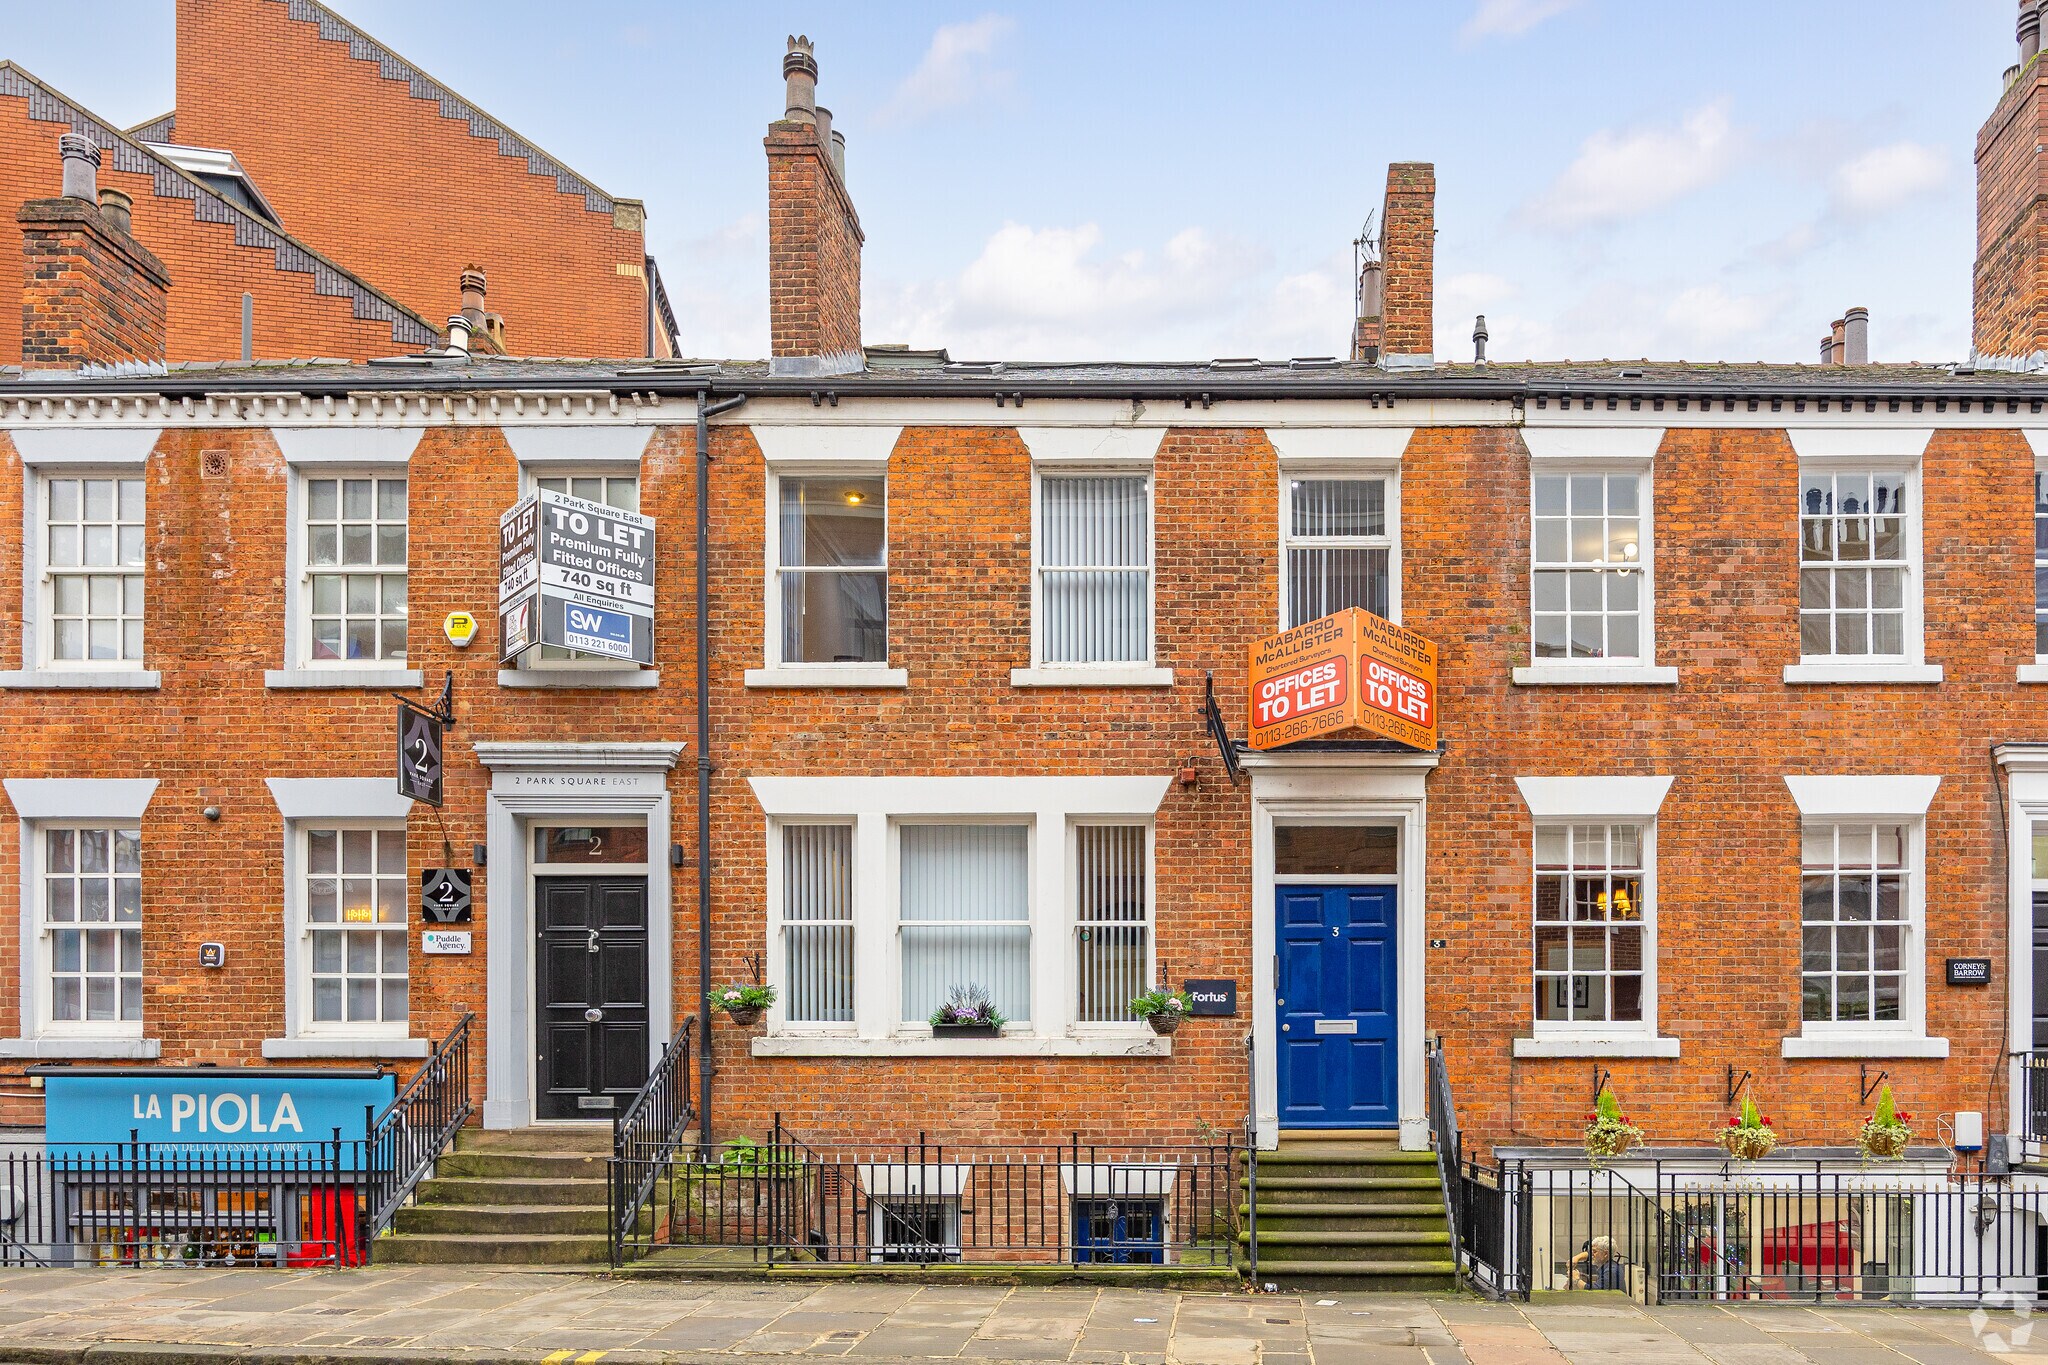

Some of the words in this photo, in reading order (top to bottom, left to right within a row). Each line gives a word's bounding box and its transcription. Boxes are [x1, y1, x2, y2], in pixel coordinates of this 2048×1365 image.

[554, 494, 560, 503] 2
[563, 497, 585, 510] Park
[588, 503, 620, 519] Square
[623, 512, 643, 525] East
[502, 522, 515, 547] TO
[517, 506, 535, 538] LET
[552, 506, 589, 535] TO
[598, 519, 645, 550] LET
[502, 542, 522, 564] Premium
[522, 533, 534, 550] Fully
[550, 532, 611, 558] Premium
[615, 548, 645, 568] Fully
[502, 561, 516, 580] Fitted
[516, 551, 534, 570] Offices
[504, 578, 514, 594] 740
[516, 574, 522, 588] sq
[524, 568, 528, 581] ft
[553, 550, 592, 572] Fitted
[596, 560, 643, 581] Offices
[560, 570, 590, 587] 740
[596, 579, 614, 596] sq
[620, 582, 632, 596] ft
[574, 593, 584, 601] All
[586, 596, 624, 610] Enquiries
[570, 610, 602, 632] SW
[1263, 618, 1335, 652] NABARRO
[1370, 616, 1426, 651] NABARRO
[569, 634, 589, 646] 0113
[592, 638, 606, 648] 221
[608, 642, 628, 653] 6000
[1255, 628, 1343, 666] McALLISTER
[1363, 626, 1432, 666] McALLISTER
[1266, 657, 1298, 674] Chartered
[1299, 648, 1332, 664] Surveyors
[1372, 646, 1400, 664] Chartered
[1400, 657, 1424, 674] Surveyors
[1261, 663, 1337, 699] OFFICES
[1368, 662, 1426, 700] OFFICES
[1258, 696, 1290, 722] TO
[1296, 680, 1340, 712] LET
[1366, 679, 1393, 708] TO
[1397, 691, 1429, 722] LET
[1255, 710, 1344, 747] 0113-266-7666
[1363, 710, 1432, 746] 0113-266-7666
[415, 738, 428, 773] 2
[526, 777, 555, 785] PARK
[561, 777, 607, 786] SQUARE
[613, 778, 639, 786] EAST
[588, 836, 602, 856] 2
[439, 882, 454, 902] 2
[436, 934, 462, 943] Puddle
[1332, 927, 1340, 937] 3
[1433, 940, 1441, 948] 3
[1192, 992, 1227, 1002] Fortus
[133, 1094, 162, 1119] LA
[172, 1092, 304, 1134] PIOLA
[182, 1143, 259, 1152] DELICATESSEN
[262, 1143, 270, 1152] &
[273, 1143, 304, 1152] MORE
[1718, 1162, 1732, 1182] 4
